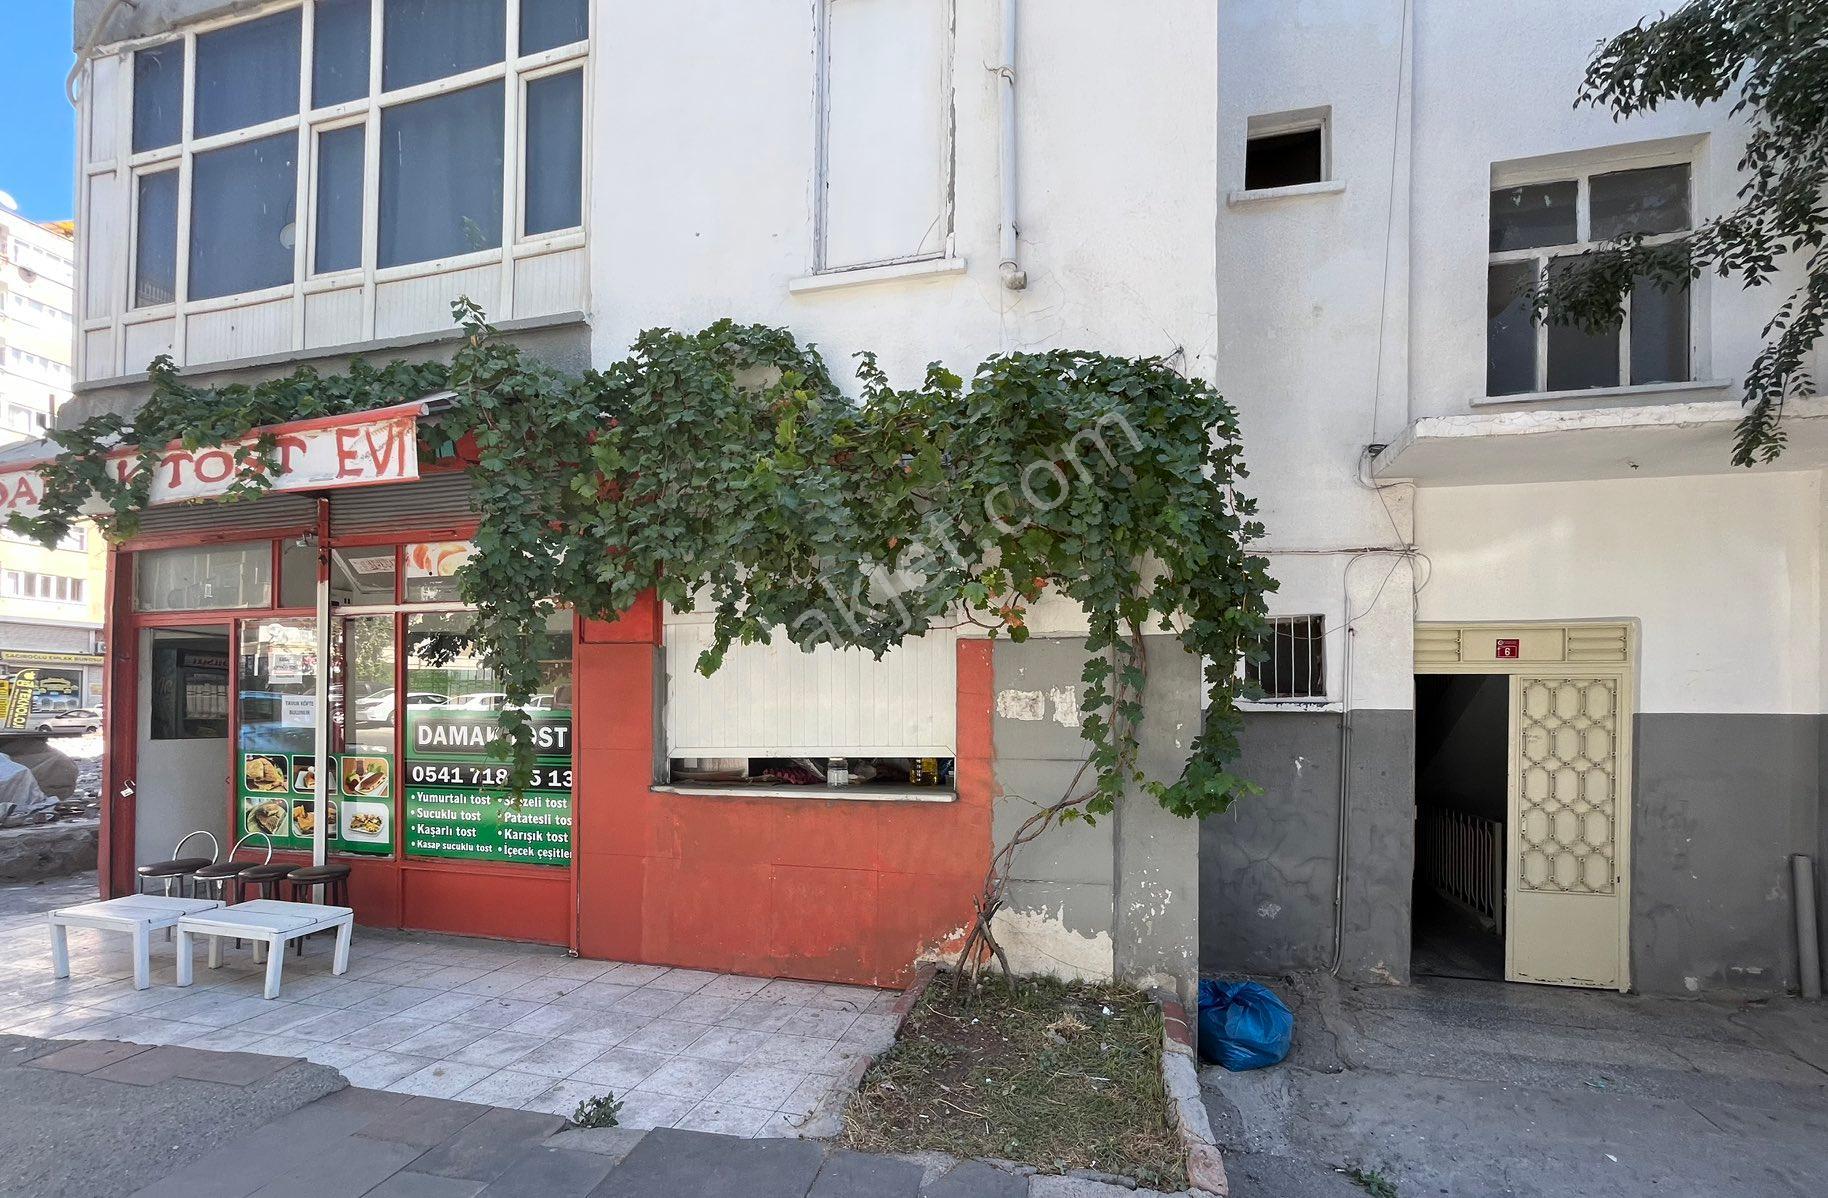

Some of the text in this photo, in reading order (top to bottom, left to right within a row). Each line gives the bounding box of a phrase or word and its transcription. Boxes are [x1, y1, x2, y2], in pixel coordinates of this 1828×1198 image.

[1504, 647, 1511, 656] 6
[412, 766, 464, 783] 0541
[469, 768, 508, 785] 718
[548, 770, 573, 787] 13
[416, 791, 491, 805] Yumurtalı tost
[503, 796, 568, 808] Szeli tost
[416, 808, 481, 821] Sucuklu tost
[504, 812, 572, 826] Patatesli tos
[416, 824, 477, 837] Kaşarlı tost
[504, 828, 568, 843] Karışık tost
[416, 840, 493, 852] Kasap sucuklu tost
[504, 842, 534, 857] İçecek
